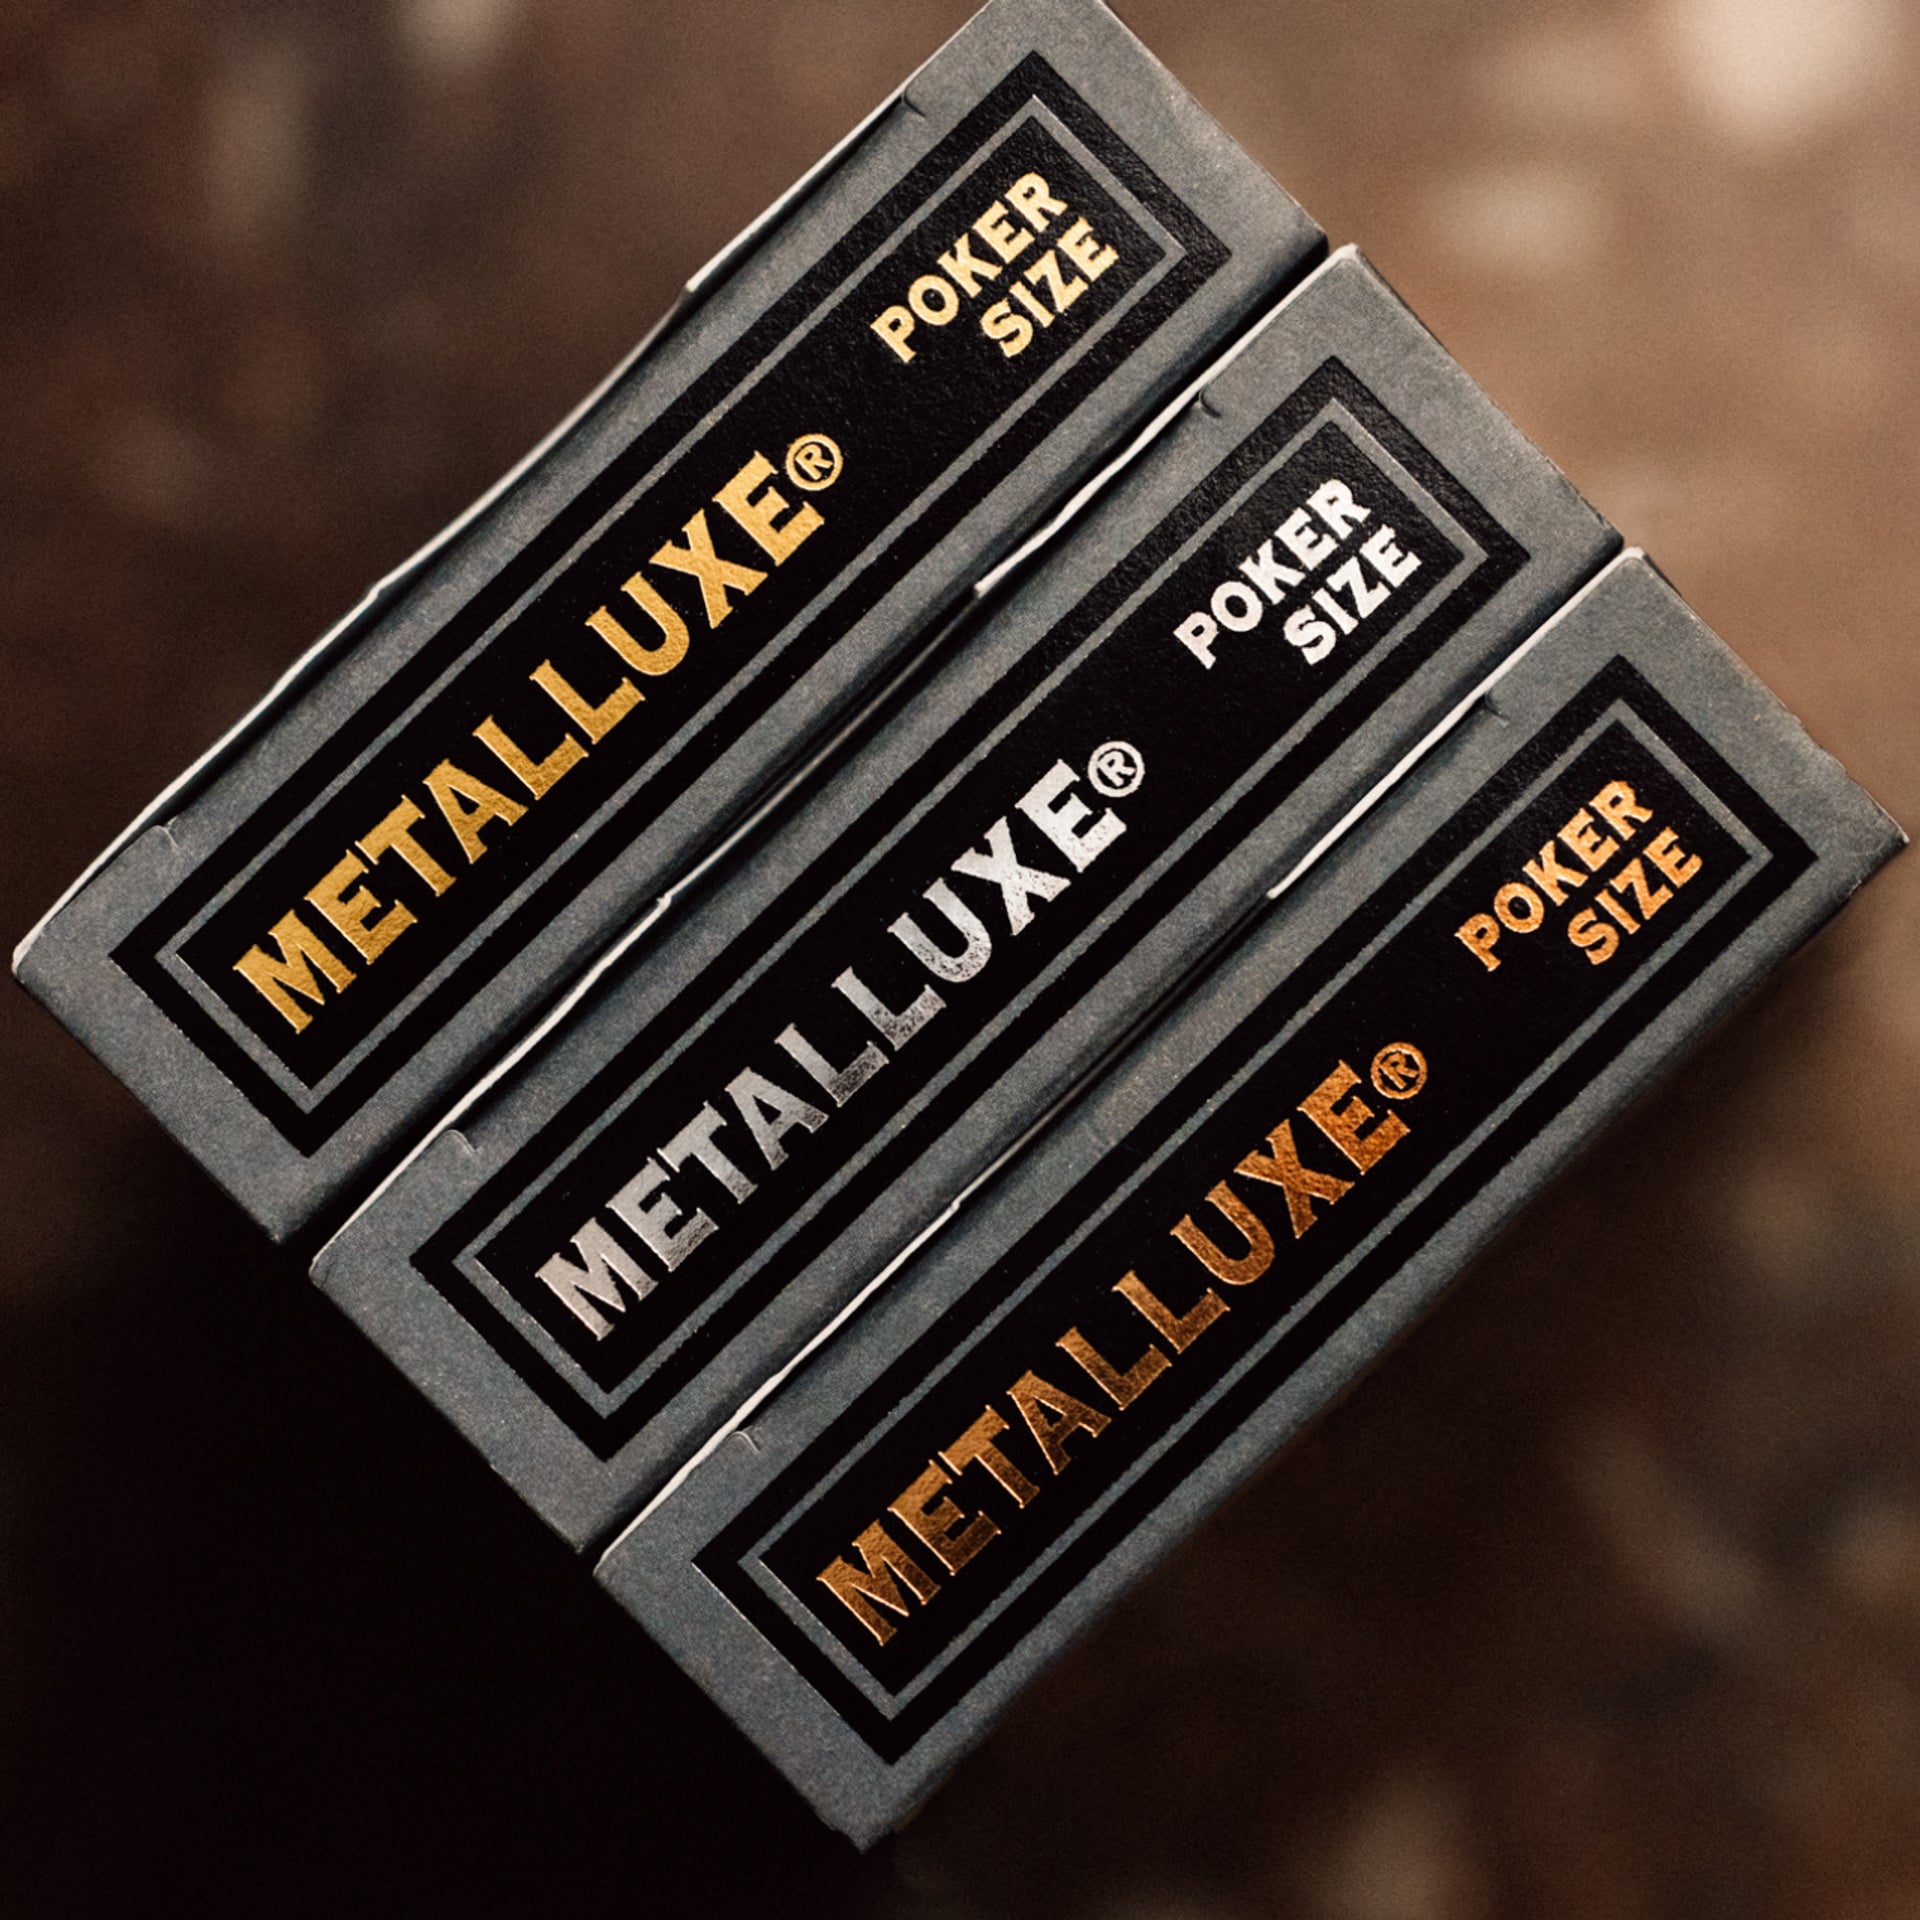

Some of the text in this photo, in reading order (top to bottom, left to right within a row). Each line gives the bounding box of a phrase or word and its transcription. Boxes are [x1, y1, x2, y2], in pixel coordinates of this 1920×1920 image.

[870, 172, 1067, 364] POKER
[979, 217, 1118, 358] SIZE
[1173, 479, 1370, 669] POKER
[1283, 525, 1422, 665] SIZE
[1454, 781, 1653, 972] POKER
[1568, 827, 1702, 966] SIZE
